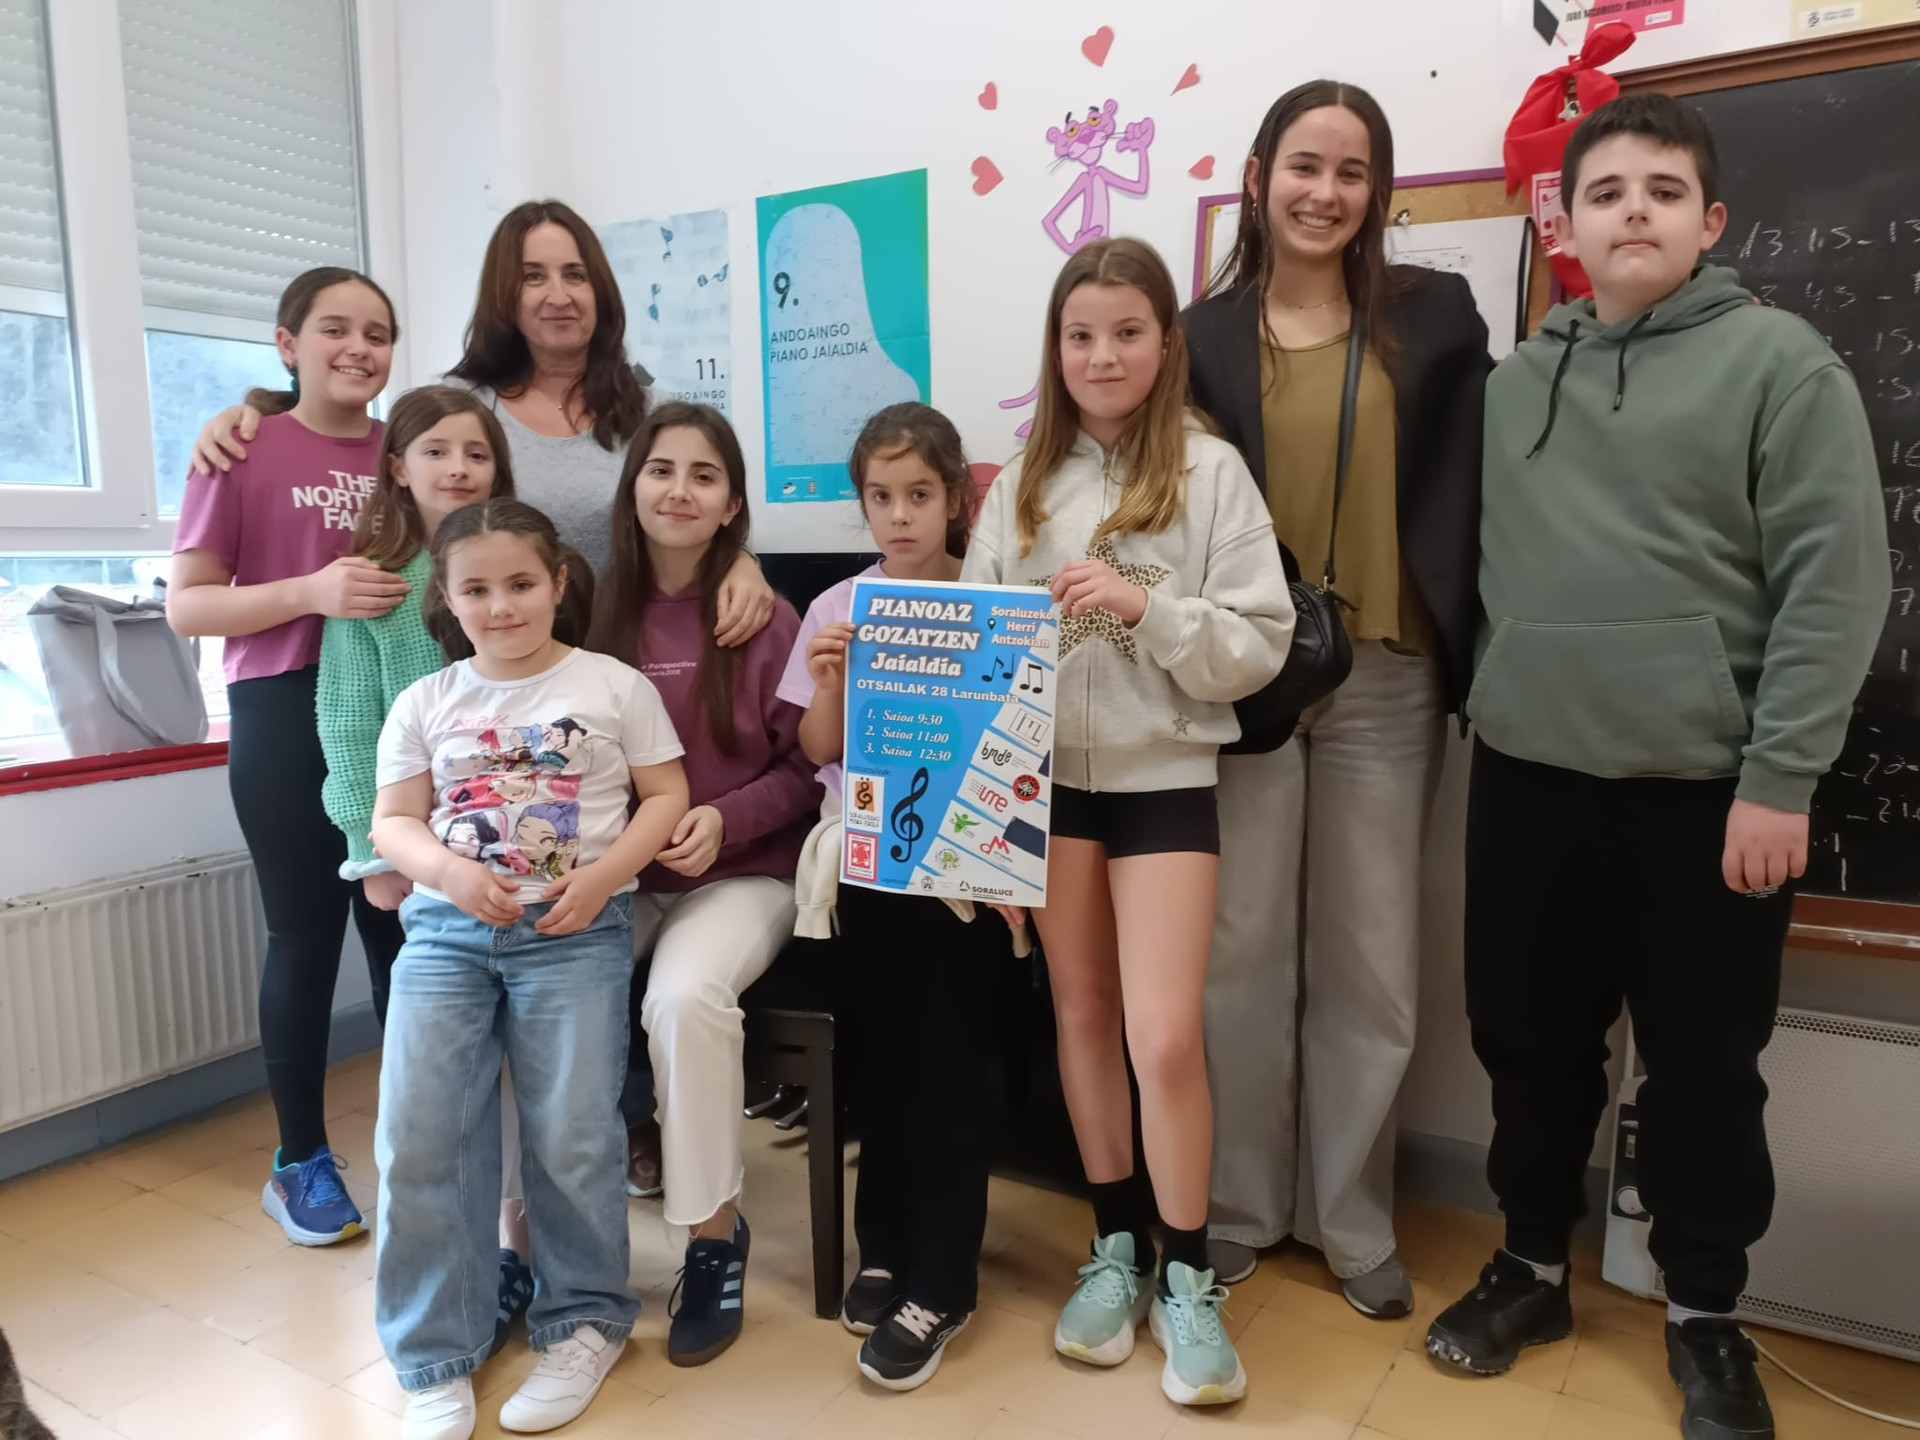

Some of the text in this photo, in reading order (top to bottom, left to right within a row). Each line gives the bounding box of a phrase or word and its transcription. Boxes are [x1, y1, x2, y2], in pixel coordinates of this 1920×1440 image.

[773, 271, 799, 310] 9.
[770, 322, 850, 345] ANDOAINGO
[770, 340, 869, 363] PIANO JAIALDIA
[695, 358, 725, 380] 11.
[328, 469, 377, 493] THE
[291, 485, 370, 510] NORT
[867, 598, 973, 622] PIANOAZ
[991, 606, 1054, 621] Soraluzeko
[857, 624, 980, 650] GOZATZEN
[1006, 621, 1036, 633] Herri
[991, 634, 1050, 649] Antzokian
[870, 652, 962, 677] Jaialdia
[856, 679, 1020, 704] OTSAILAK 28 Larunbata
[867, 708, 943, 726] 1. Saioa 9:30
[865, 725, 950, 744] 2. Saioa 11:00
[864, 742, 952, 762] 3. Saioa 12:30
[972, 886, 1013, 897] SORALUCE
